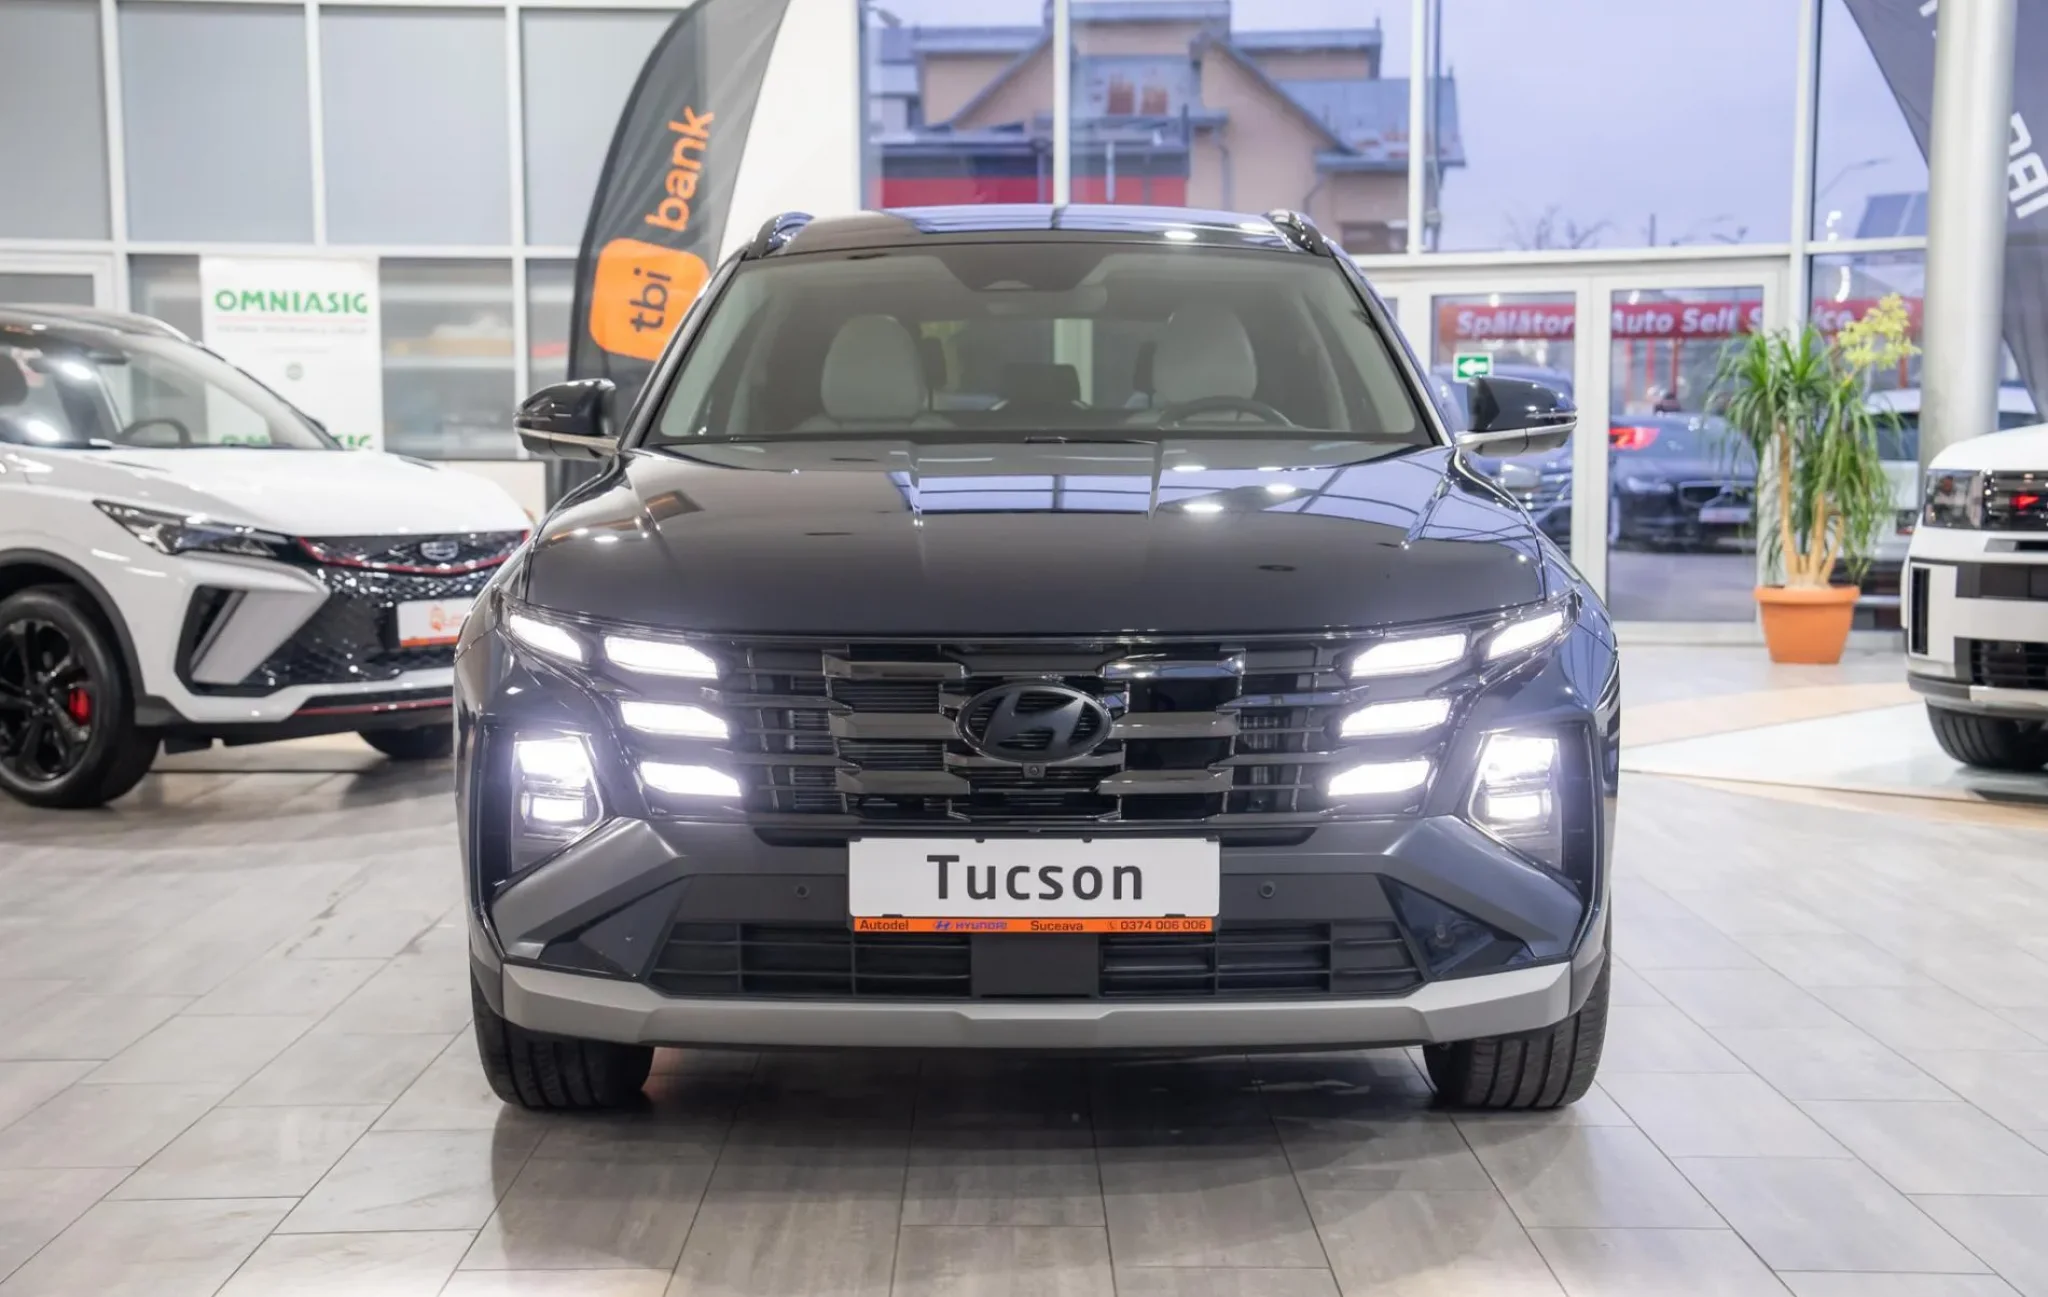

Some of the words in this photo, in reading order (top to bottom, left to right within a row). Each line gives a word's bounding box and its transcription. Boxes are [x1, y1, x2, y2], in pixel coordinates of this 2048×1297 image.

[644, 105, 715, 232] bank
[214, 290, 368, 314] OMNIASIG
[629, 266, 672, 333] tbi
[1612, 309, 1674, 333] Auto
[926, 854, 1142, 901] Tucson
[859, 919, 909, 931] Autodel
[955, 921, 1008, 930] HYUNDAI
[1030, 920, 1084, 931] Suceava
[1120, 920, 1152, 931] 0374
[1155, 920, 1179, 931] 006
[1182, 920, 1207, 931] 006
